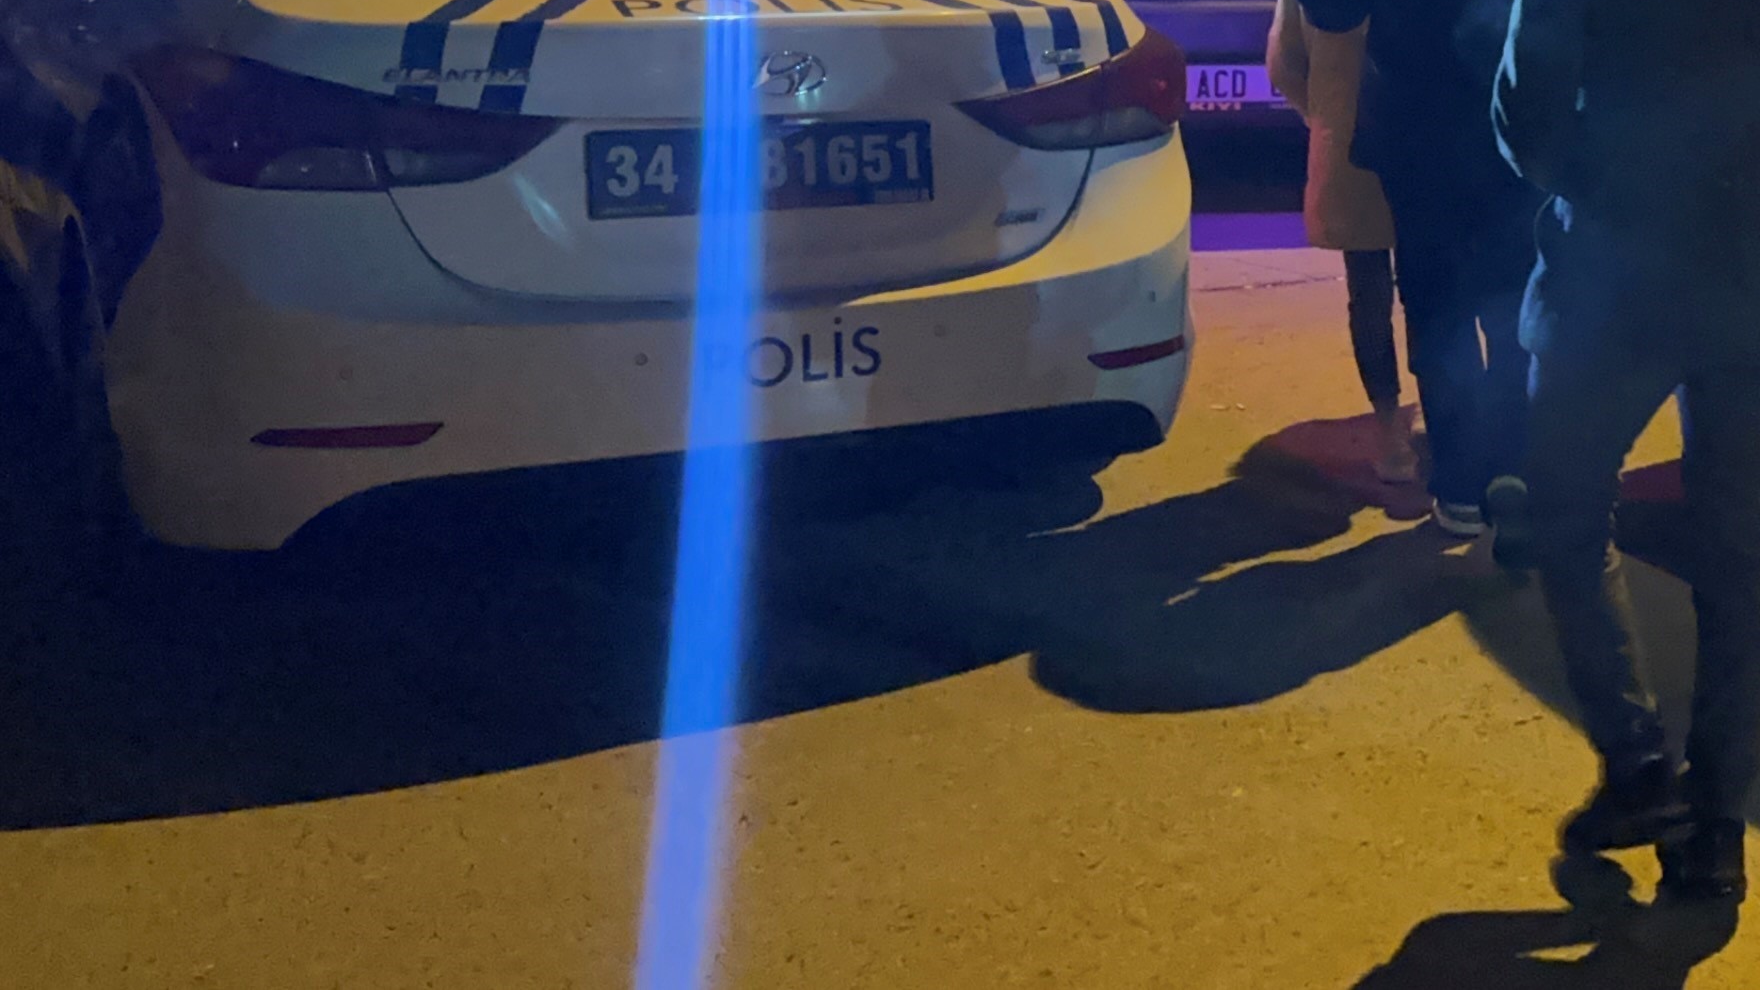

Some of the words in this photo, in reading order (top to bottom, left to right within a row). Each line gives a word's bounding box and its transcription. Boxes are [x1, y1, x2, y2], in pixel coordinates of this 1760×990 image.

[1196, 69, 1247, 98] ACD
[605, 144, 679, 198] 34
[704, 316, 882, 388] OLİS
